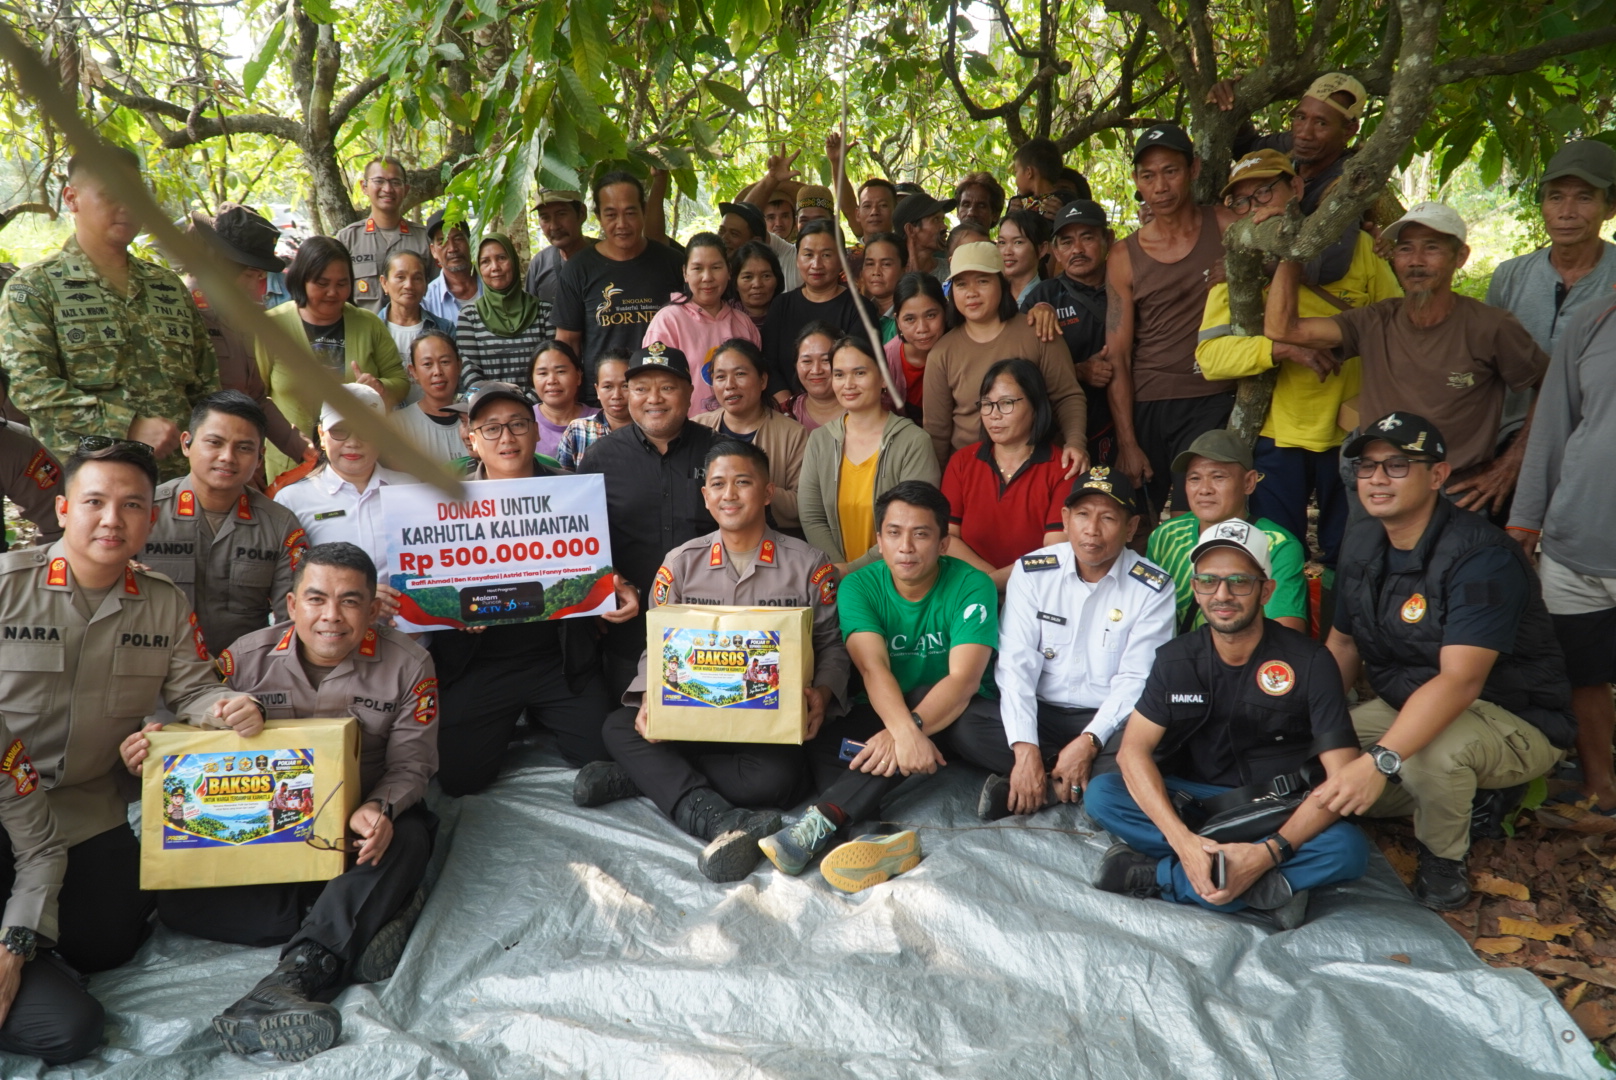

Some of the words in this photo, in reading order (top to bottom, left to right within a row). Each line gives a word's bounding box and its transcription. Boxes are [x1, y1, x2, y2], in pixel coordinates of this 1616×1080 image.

[152, 305, 173, 315] TNI
[176, 309, 190, 318] AL
[437, 499, 496, 521] DONASI
[501, 495, 552, 516] UNTUK
[402, 523, 485, 546] KARHUTLA
[491, 514, 589, 539] KALIMANTAN
[145, 543, 194, 555] PANDU
[236, 547, 279, 562] POLRI
[400, 552, 434, 576] Rp
[440, 536, 600, 568] 500.000.000
[467, 574, 500, 582] Kasyafani
[503, 571, 522, 579] Astrid
[543, 568, 562, 576] Fanny
[563, 566, 592, 574] Ghassani
[4, 626, 60, 641] NARA
[121, 633, 169, 648] POLRI
[696, 651, 745, 666] BAKSOS
[256, 693, 287, 705] HYUDI
[353, 696, 397, 713] POLRI
[1171, 694, 1204, 703] HAIKAL
[208, 775, 272, 795] BAKSOS
